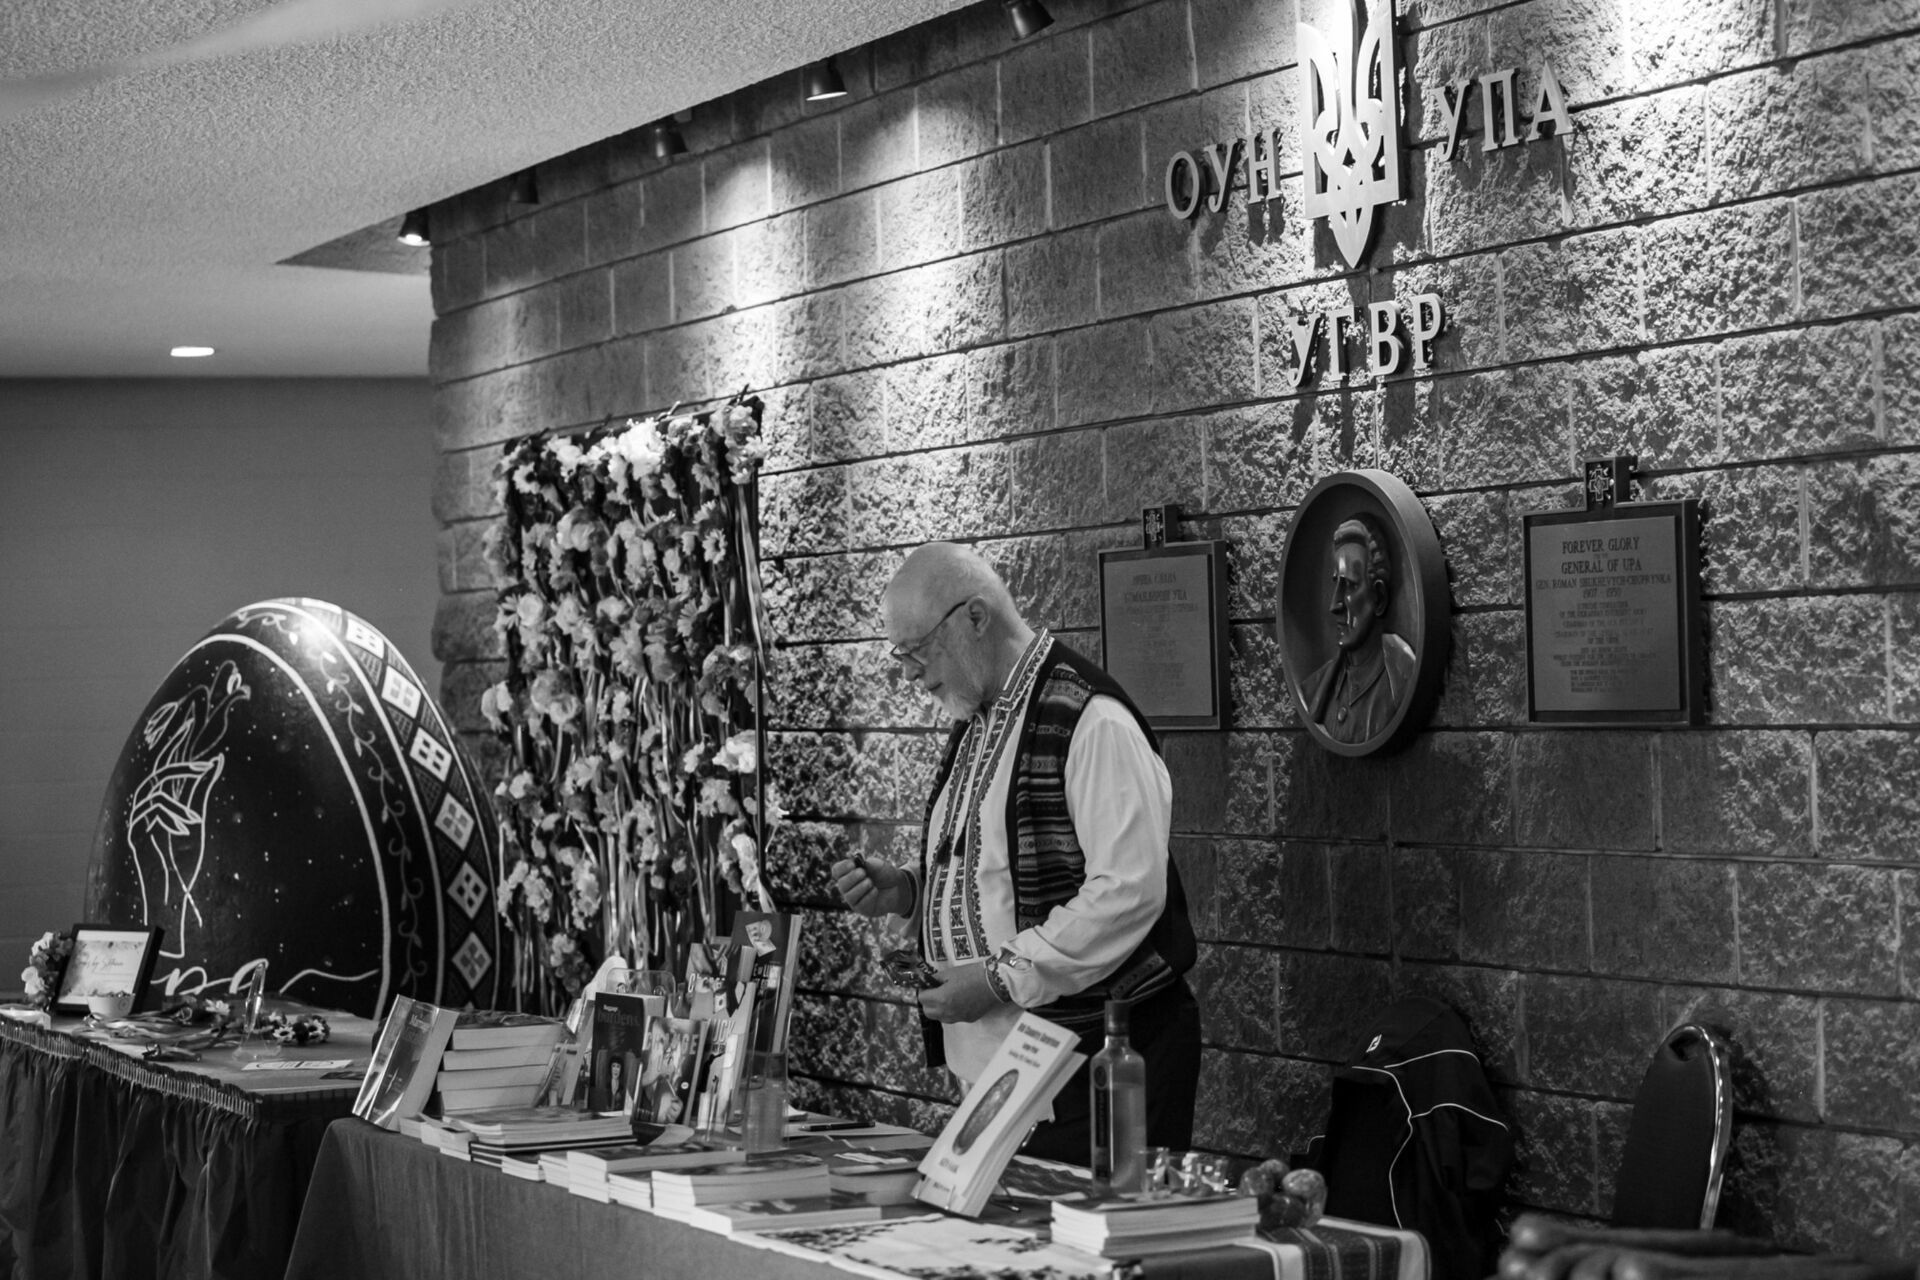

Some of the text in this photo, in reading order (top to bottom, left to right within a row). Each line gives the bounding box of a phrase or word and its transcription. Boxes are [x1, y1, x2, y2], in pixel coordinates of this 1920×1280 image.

[1433, 62, 1575, 162] УПА
[1165, 128, 1284, 219] ОУН
[1287, 293, 1445, 387] УГВР
[1561, 558, 1642, 574] GENERAL OF UPA
[1562, 537, 1640, 554] FOREVER GLORY
